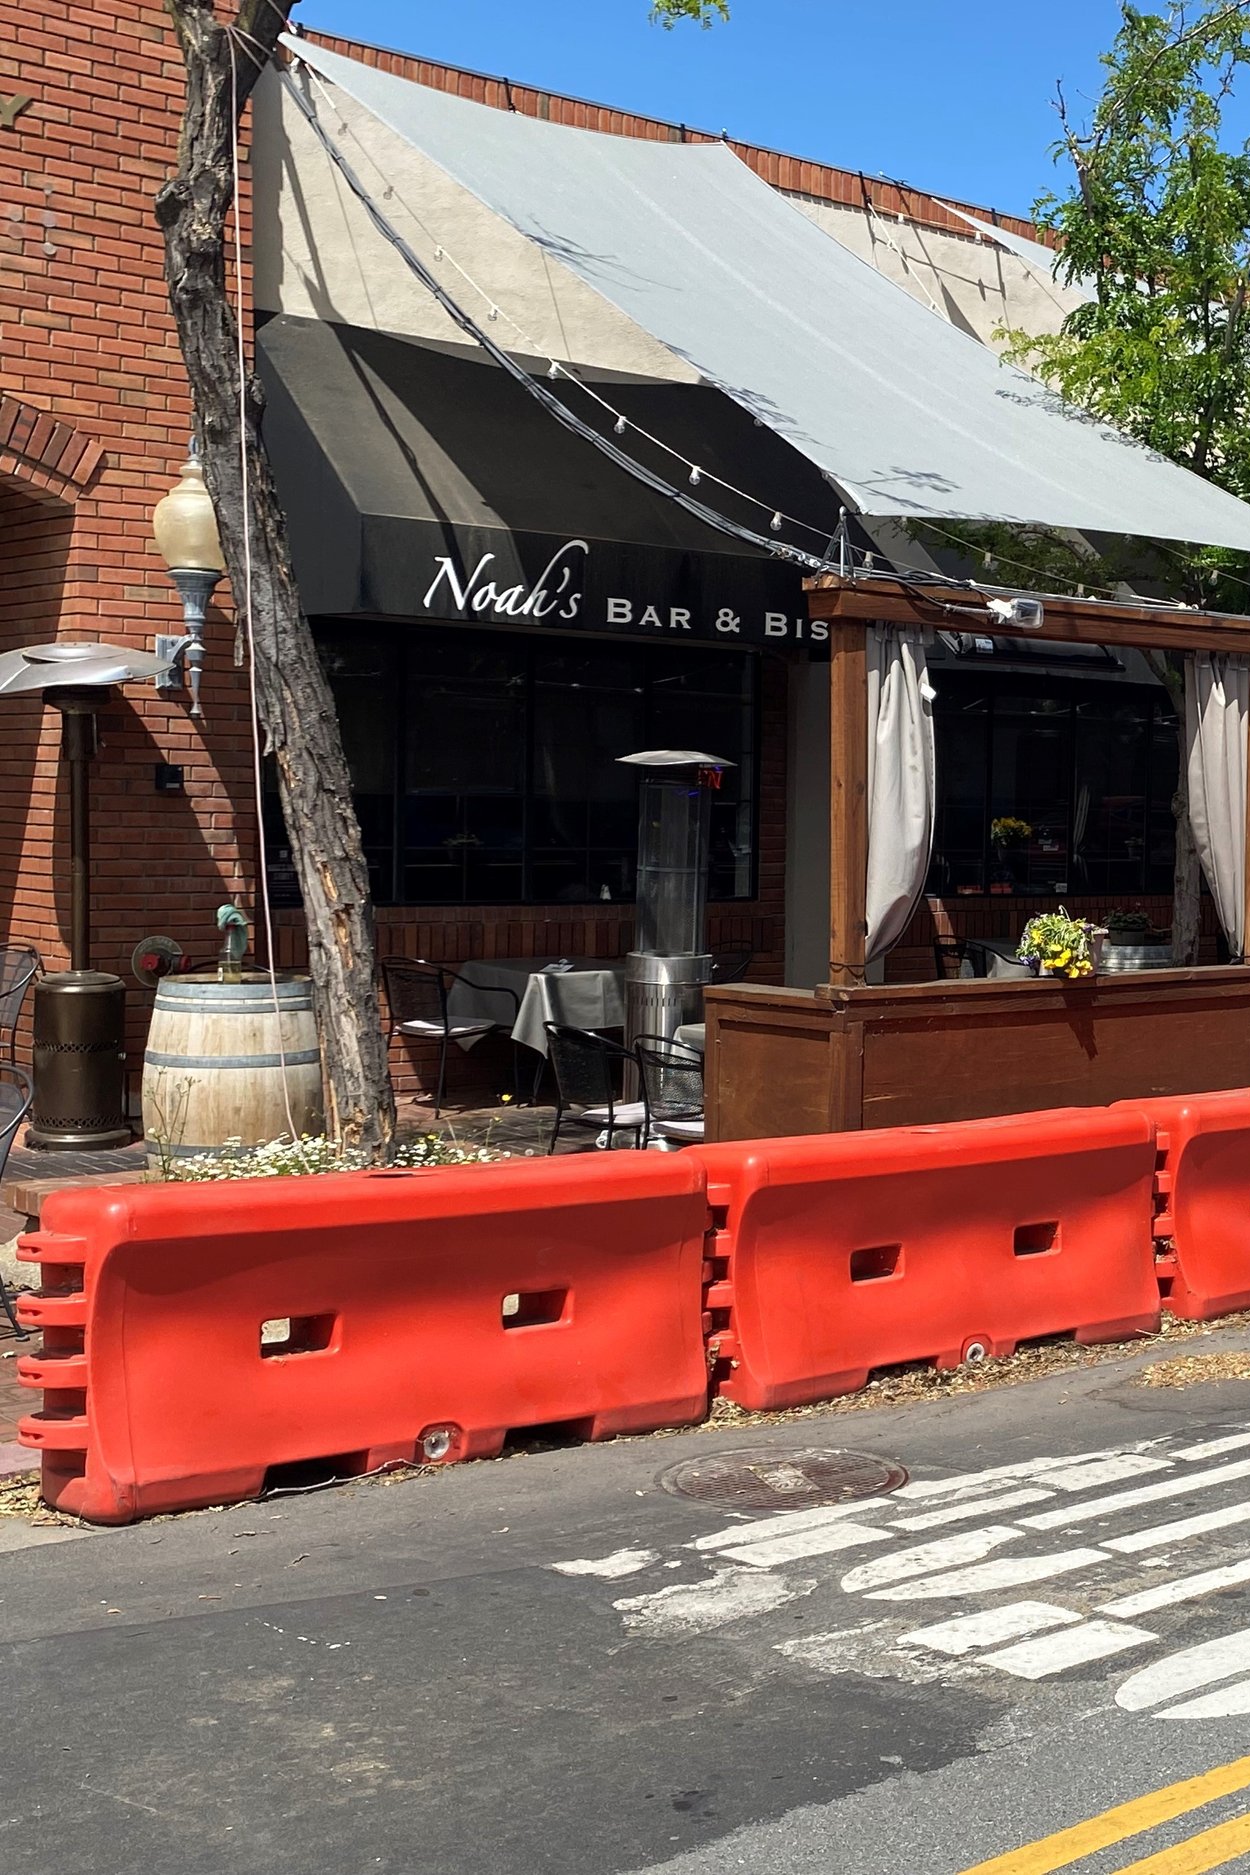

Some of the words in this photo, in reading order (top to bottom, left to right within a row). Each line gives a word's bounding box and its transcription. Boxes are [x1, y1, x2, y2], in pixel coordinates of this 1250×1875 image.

[423, 539, 589, 619] Noah's
[715, 608, 740, 633] &
[764, 612, 829, 641] BIS
